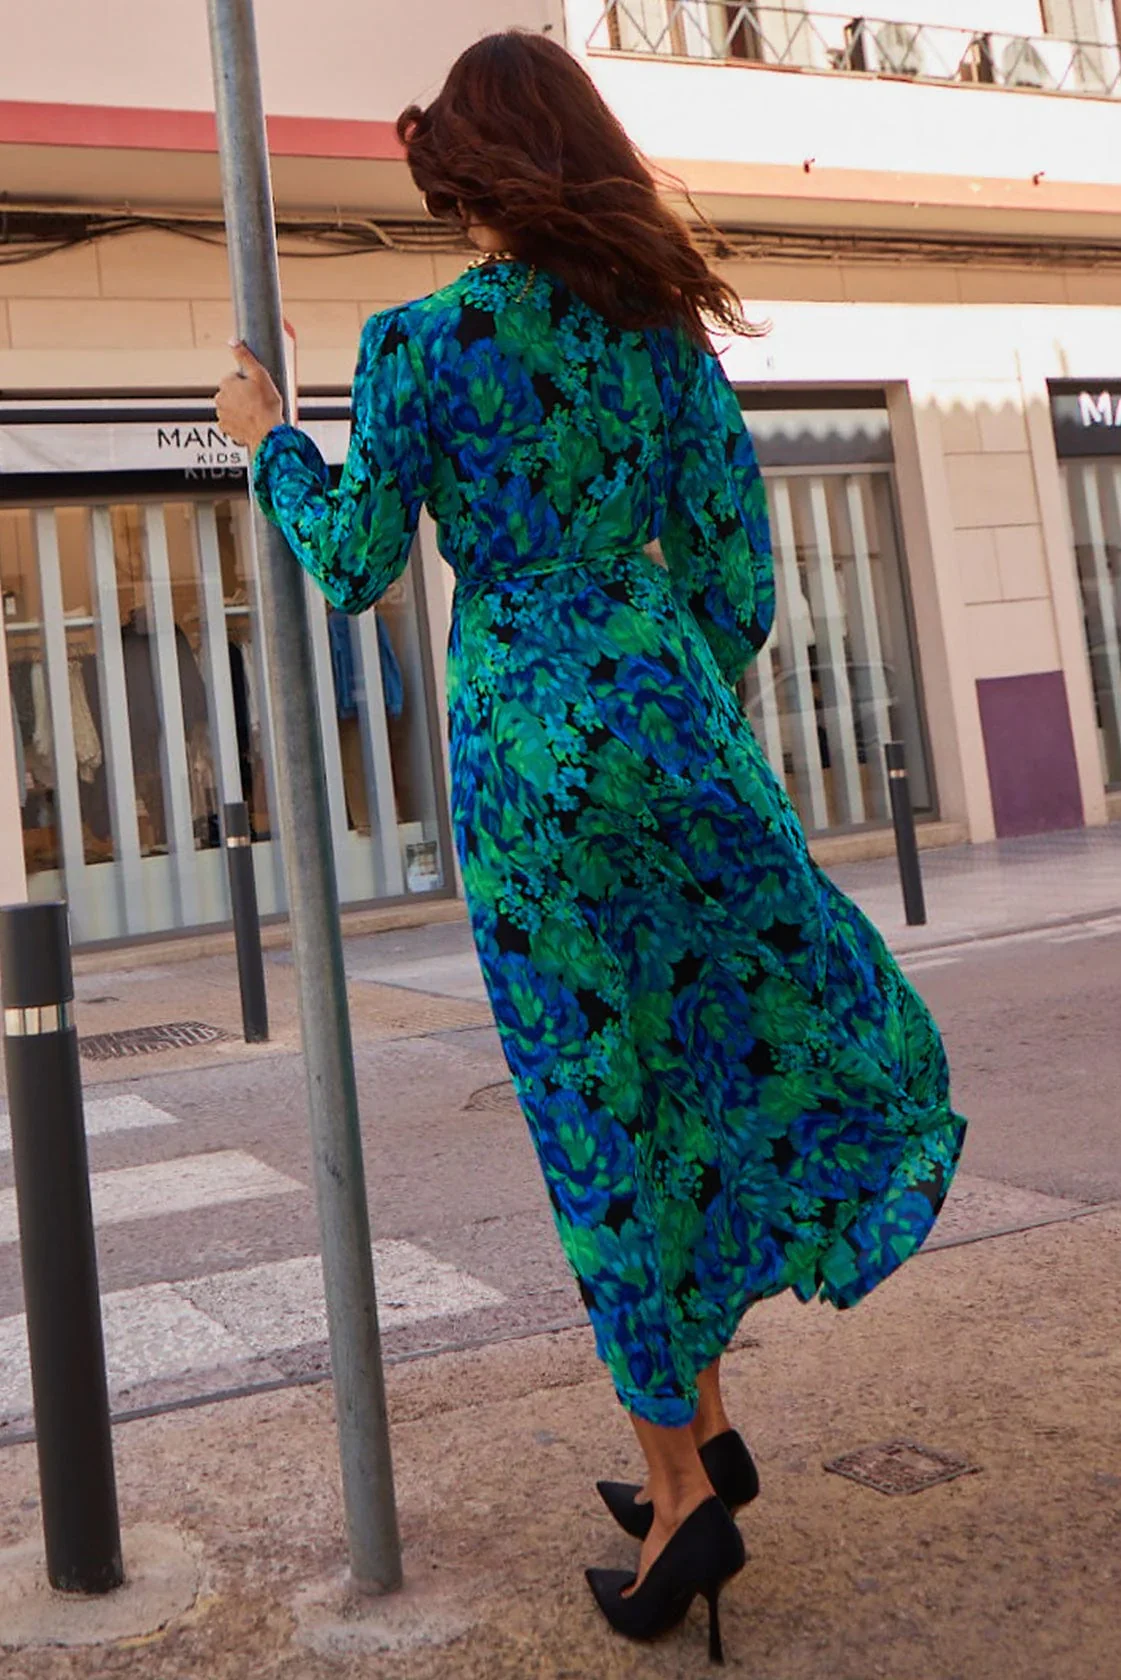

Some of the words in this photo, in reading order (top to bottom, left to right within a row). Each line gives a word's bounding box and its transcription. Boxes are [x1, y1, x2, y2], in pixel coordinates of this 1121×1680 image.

[1078, 390, 1121, 427] M
[157, 427, 247, 448] MAN
[197, 452, 241, 464] KIDS
